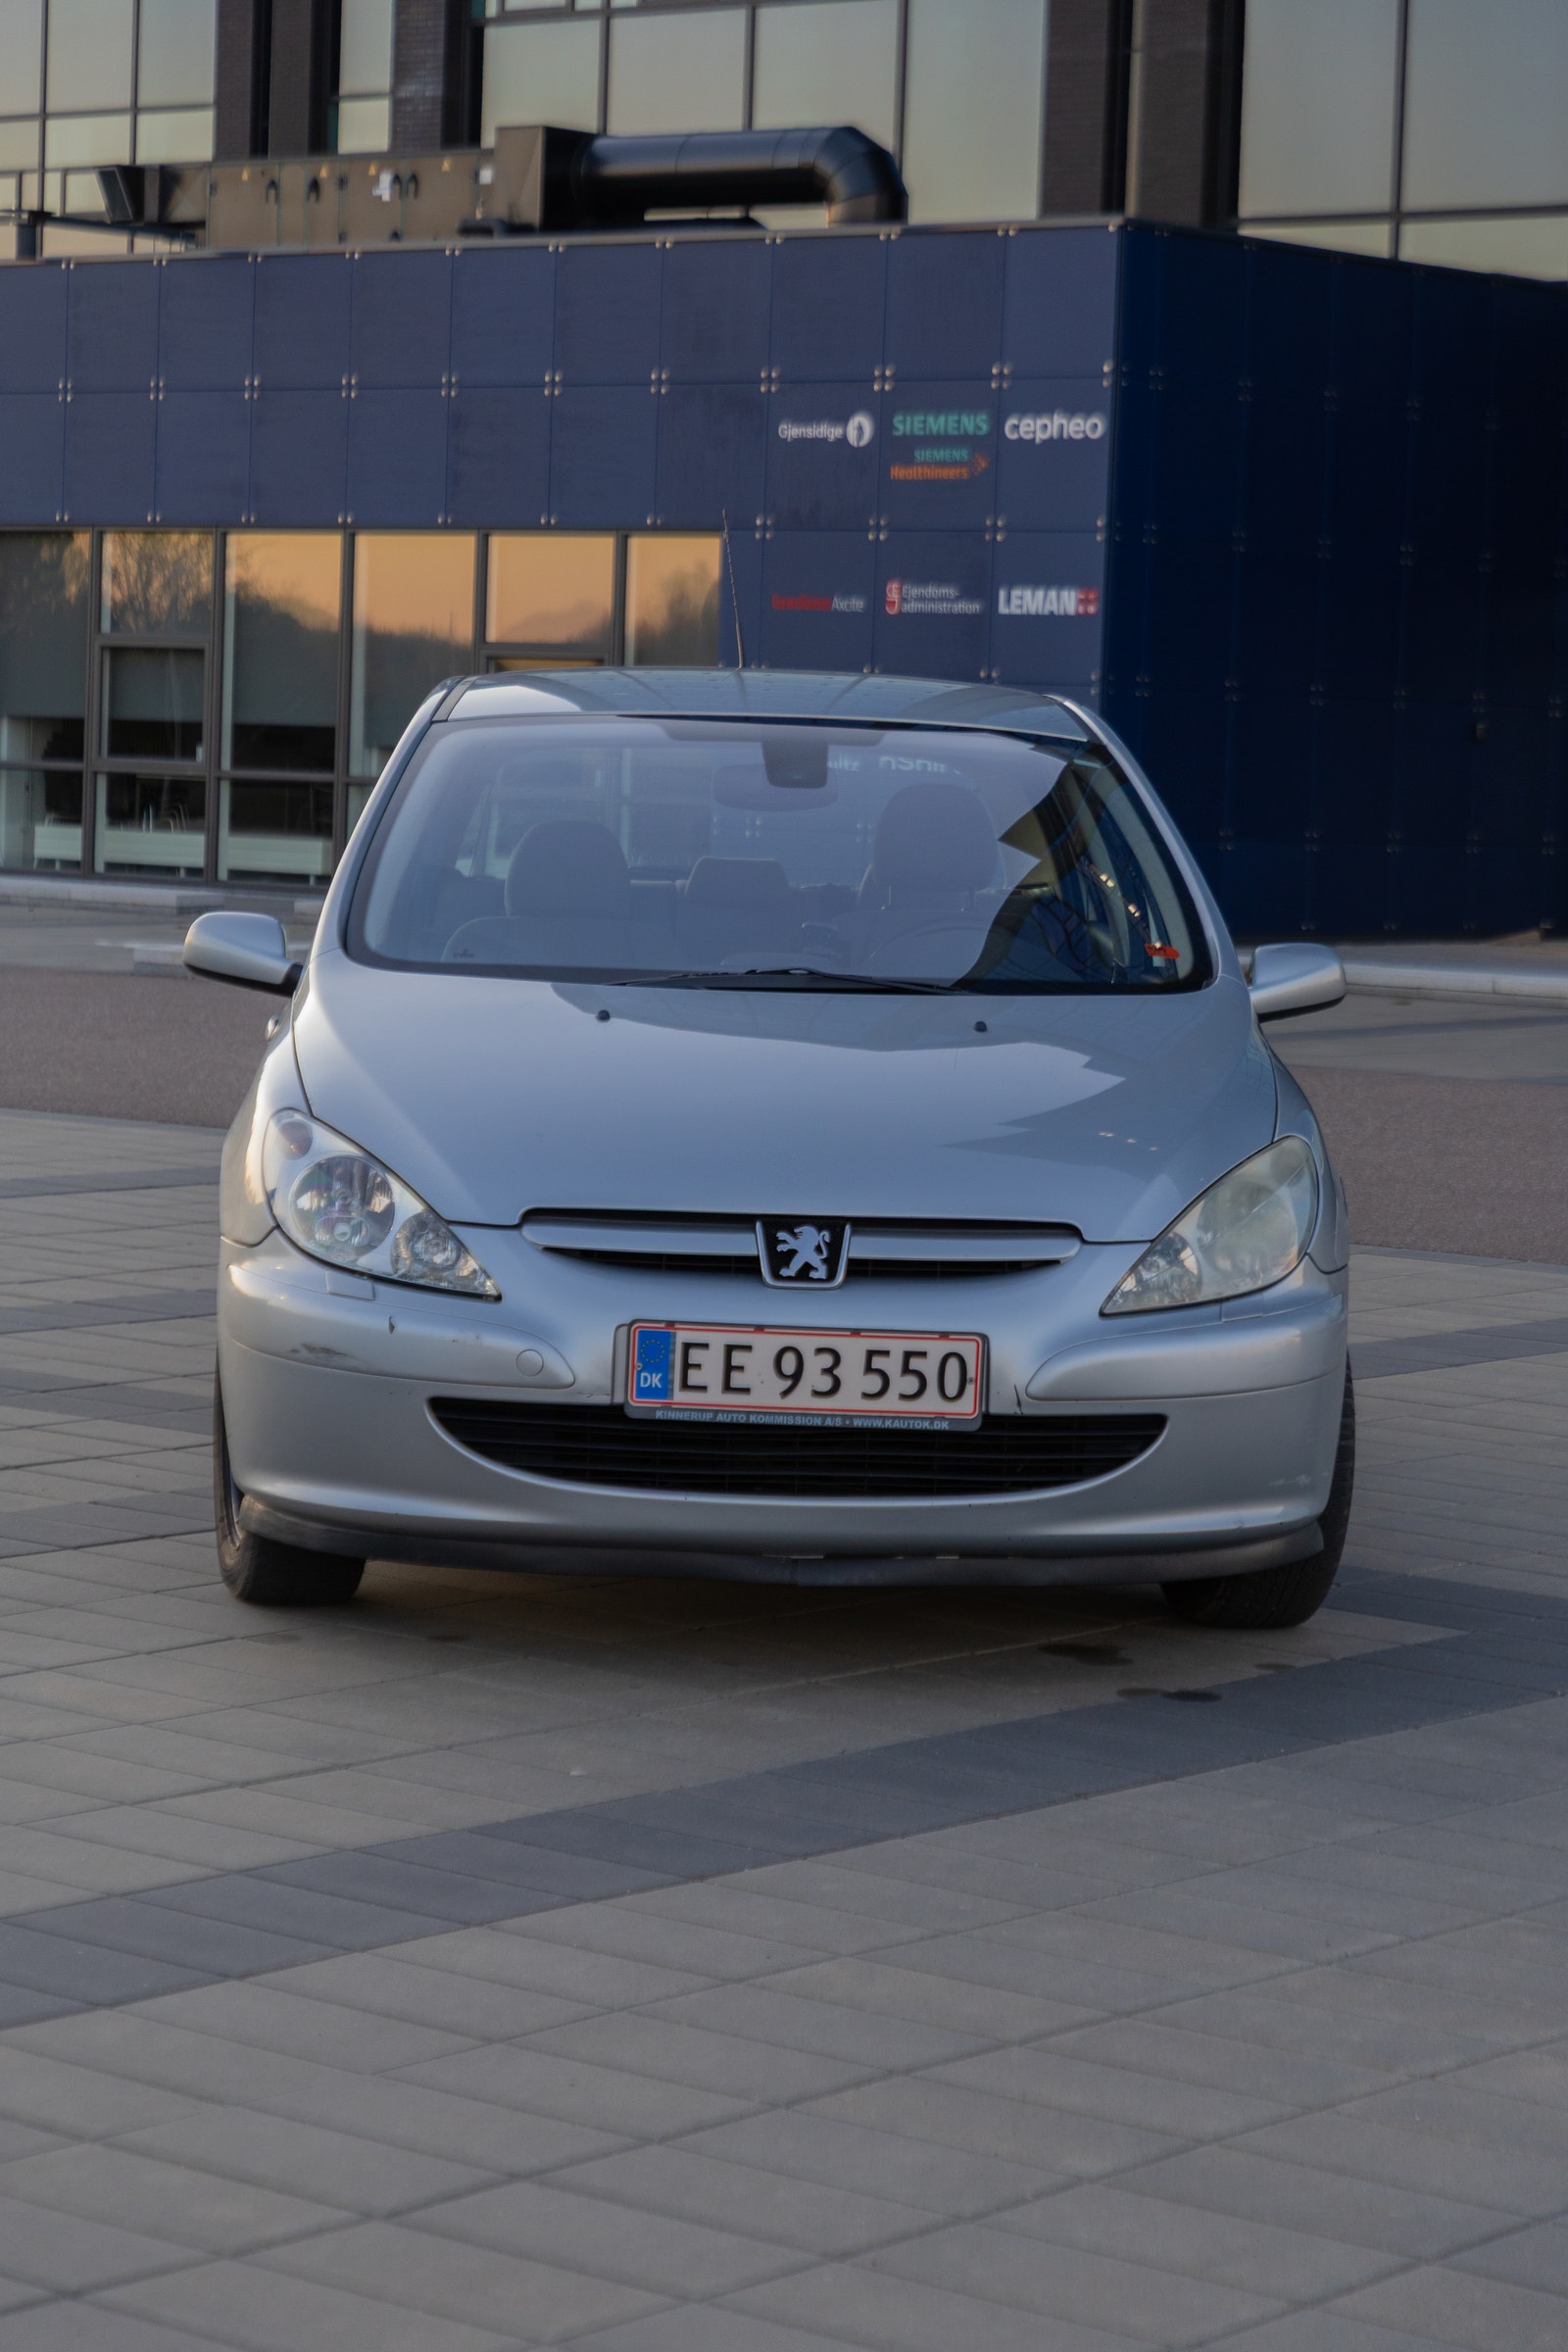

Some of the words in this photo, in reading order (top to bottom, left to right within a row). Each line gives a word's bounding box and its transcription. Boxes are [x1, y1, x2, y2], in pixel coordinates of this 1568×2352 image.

[778, 421, 843, 442] Gjensidige
[892, 413, 990, 436] SIEMENS
[1004, 413, 1107, 444] cepheo
[913, 448, 970, 463] SIEMENS
[890, 464, 970, 480] Healthineers
[902, 600, 981, 614] administration
[998, 588, 1076, 615] LEMAN
[639, 1372, 662, 1390] DK
[678, 1342, 753, 1396] EE
[772, 1346, 843, 1400] 93
[859, 1348, 968, 1404] 550
[655, 1409, 713, 1422] KINNERUP
[715, 1412, 747, 1423] AUTO
[749, 1414, 821, 1426] KOMMISSION
[823, 1417, 843, 1427] A/S
[853, 1418, 950, 1431] WWW.KAUTOK.DK
